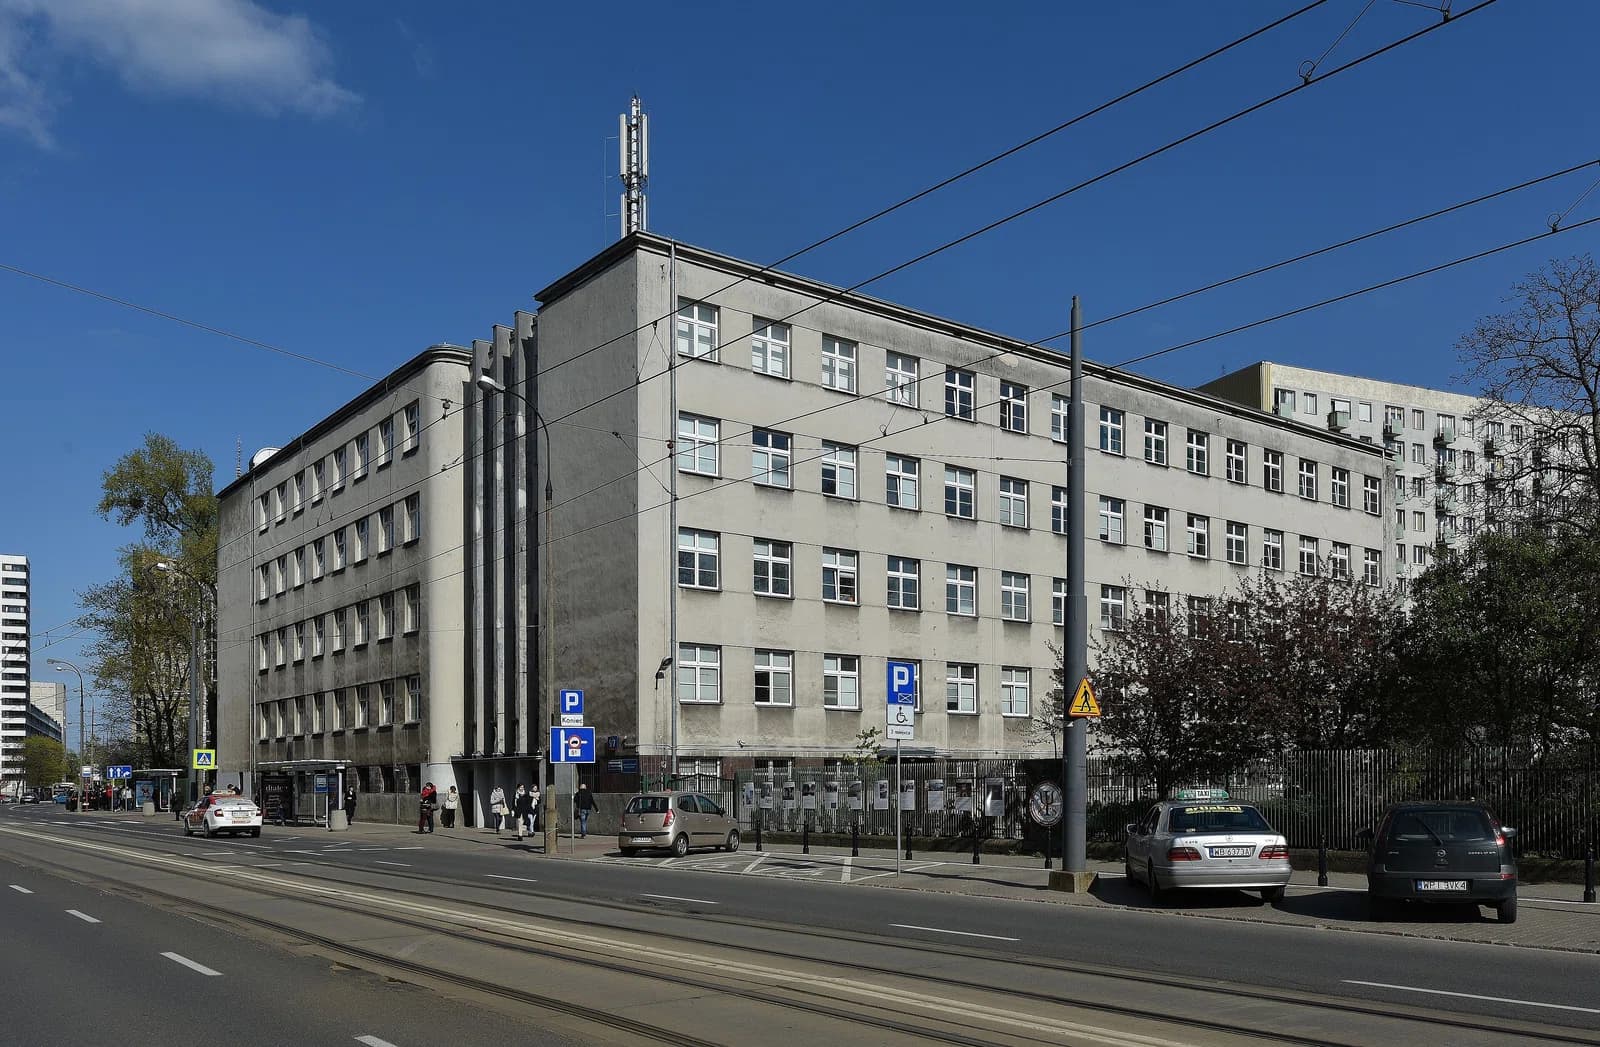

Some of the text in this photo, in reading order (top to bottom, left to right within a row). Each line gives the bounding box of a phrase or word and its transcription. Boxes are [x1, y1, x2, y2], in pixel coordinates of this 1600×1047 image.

[893, 666, 909, 692] P
[566, 693, 579, 711] P
[1214, 848, 1225, 857] WB
